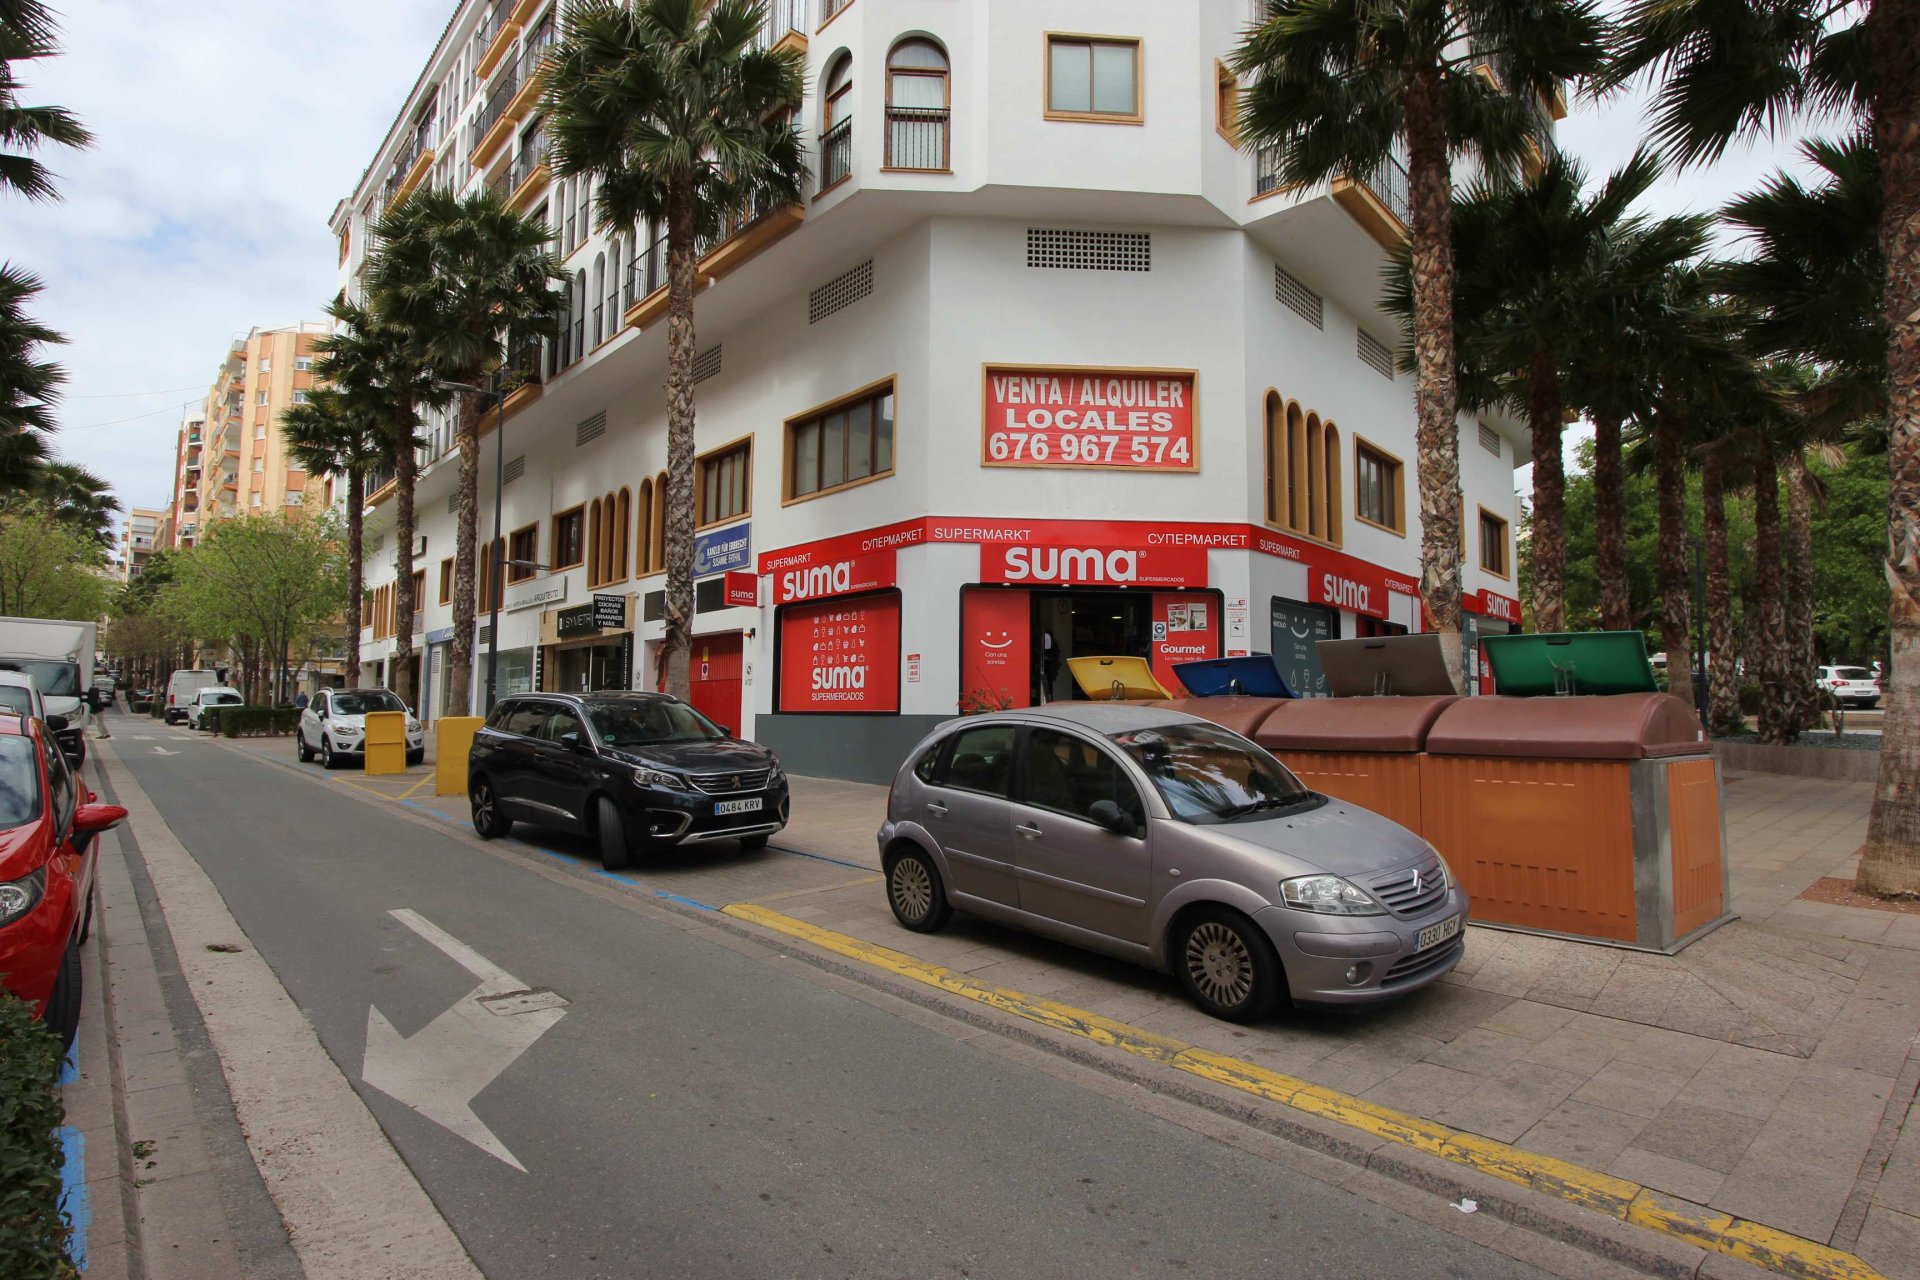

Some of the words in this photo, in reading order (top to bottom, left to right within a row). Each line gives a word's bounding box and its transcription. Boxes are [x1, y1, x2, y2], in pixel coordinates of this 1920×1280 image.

[993, 376, 1063, 405] VENTA
[1080, 378, 1184, 408] ALQUILER
[1006, 408, 1173, 432] LOCALES
[989, 432, 1049, 461] 676
[1060, 434, 1119, 462] 967
[1130, 436, 1190, 464] 574
[862, 528, 923, 551] СУПЕРМАРКЕТ
[934, 527, 1032, 541] SUPERMARKT
[1147, 533, 1247, 546] СУПЕРМАРКЕТ
[1259, 538, 1300, 559] SUPERMARKT
[766, 552, 812, 571] SUPERMARKT
[533, 589, 558, 602] ARQUITECTO
[594, 595, 625, 603] PROYECTOS
[1160, 643, 1206, 654] Gourmet
[811, 691, 864, 701] SUPERMERCADOS
[720, 802, 742, 813] 0484
[744, 800, 760, 810] KRV
[1420, 925, 1441, 948] 0330
